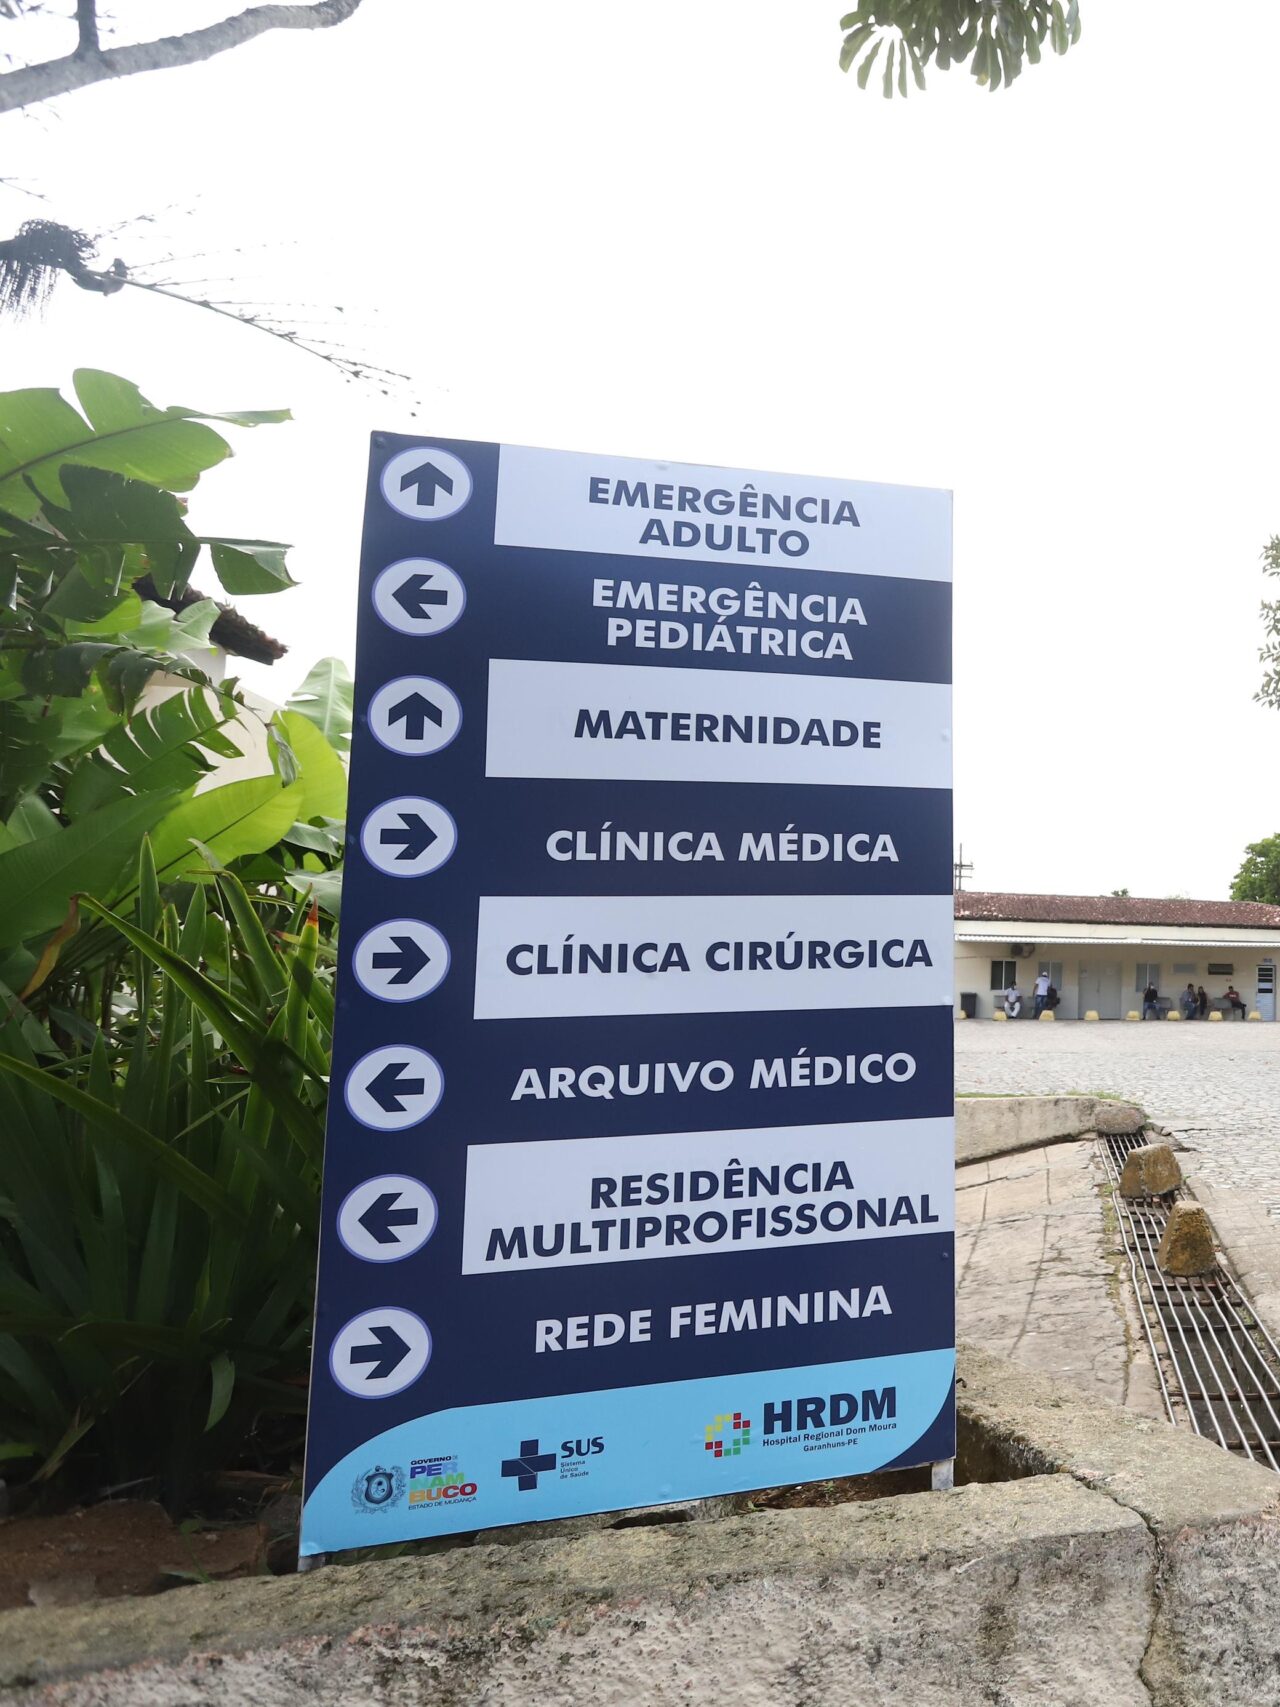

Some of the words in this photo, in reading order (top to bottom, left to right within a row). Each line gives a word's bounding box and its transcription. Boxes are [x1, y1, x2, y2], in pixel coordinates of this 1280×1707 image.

[588, 476, 861, 527] EMERGÊNCIA
[639, 518, 810, 557] ADULTO
[592, 578, 868, 626] EMERGÊNCIA
[607, 615, 854, 661] PEDIÁTRICA
[574, 708, 882, 749] MATERNIDADE
[546, 821, 725, 862] CLÍNICA
[738, 823, 899, 862] MÉDICA
[506, 934, 691, 975] CLÍNICA
[705, 931, 933, 971] CIRÚRGICA
[510, 1059, 734, 1101] ARQUIVO
[749, 1047, 917, 1089] MÉDICO
[590, 1158, 854, 1210] RESIDÊNCIA
[485, 1194, 939, 1262] MULTIPROFISSONAL
[535, 1309, 652, 1353] REDE
[670, 1285, 893, 1339] FEMININA
[763, 1386, 897, 1436] HRDM
[560, 1436, 605, 1459] SUS
[762, 1435, 801, 1447] Hospital
[803, 1430, 843, 1441] Regional
[845, 1427, 866, 1436] Dom
[868, 1422, 897, 1433] Moura
[803, 1438, 858, 1452] Garanhuns-PE
[410, 1455, 452, 1466] GOVERNO
[560, 1460, 585, 1468] Sistema
[408, 1483, 478, 1505] BUCO
[408, 1502, 434, 1511] ESTADO
[434, 1500, 443, 1508] DE
